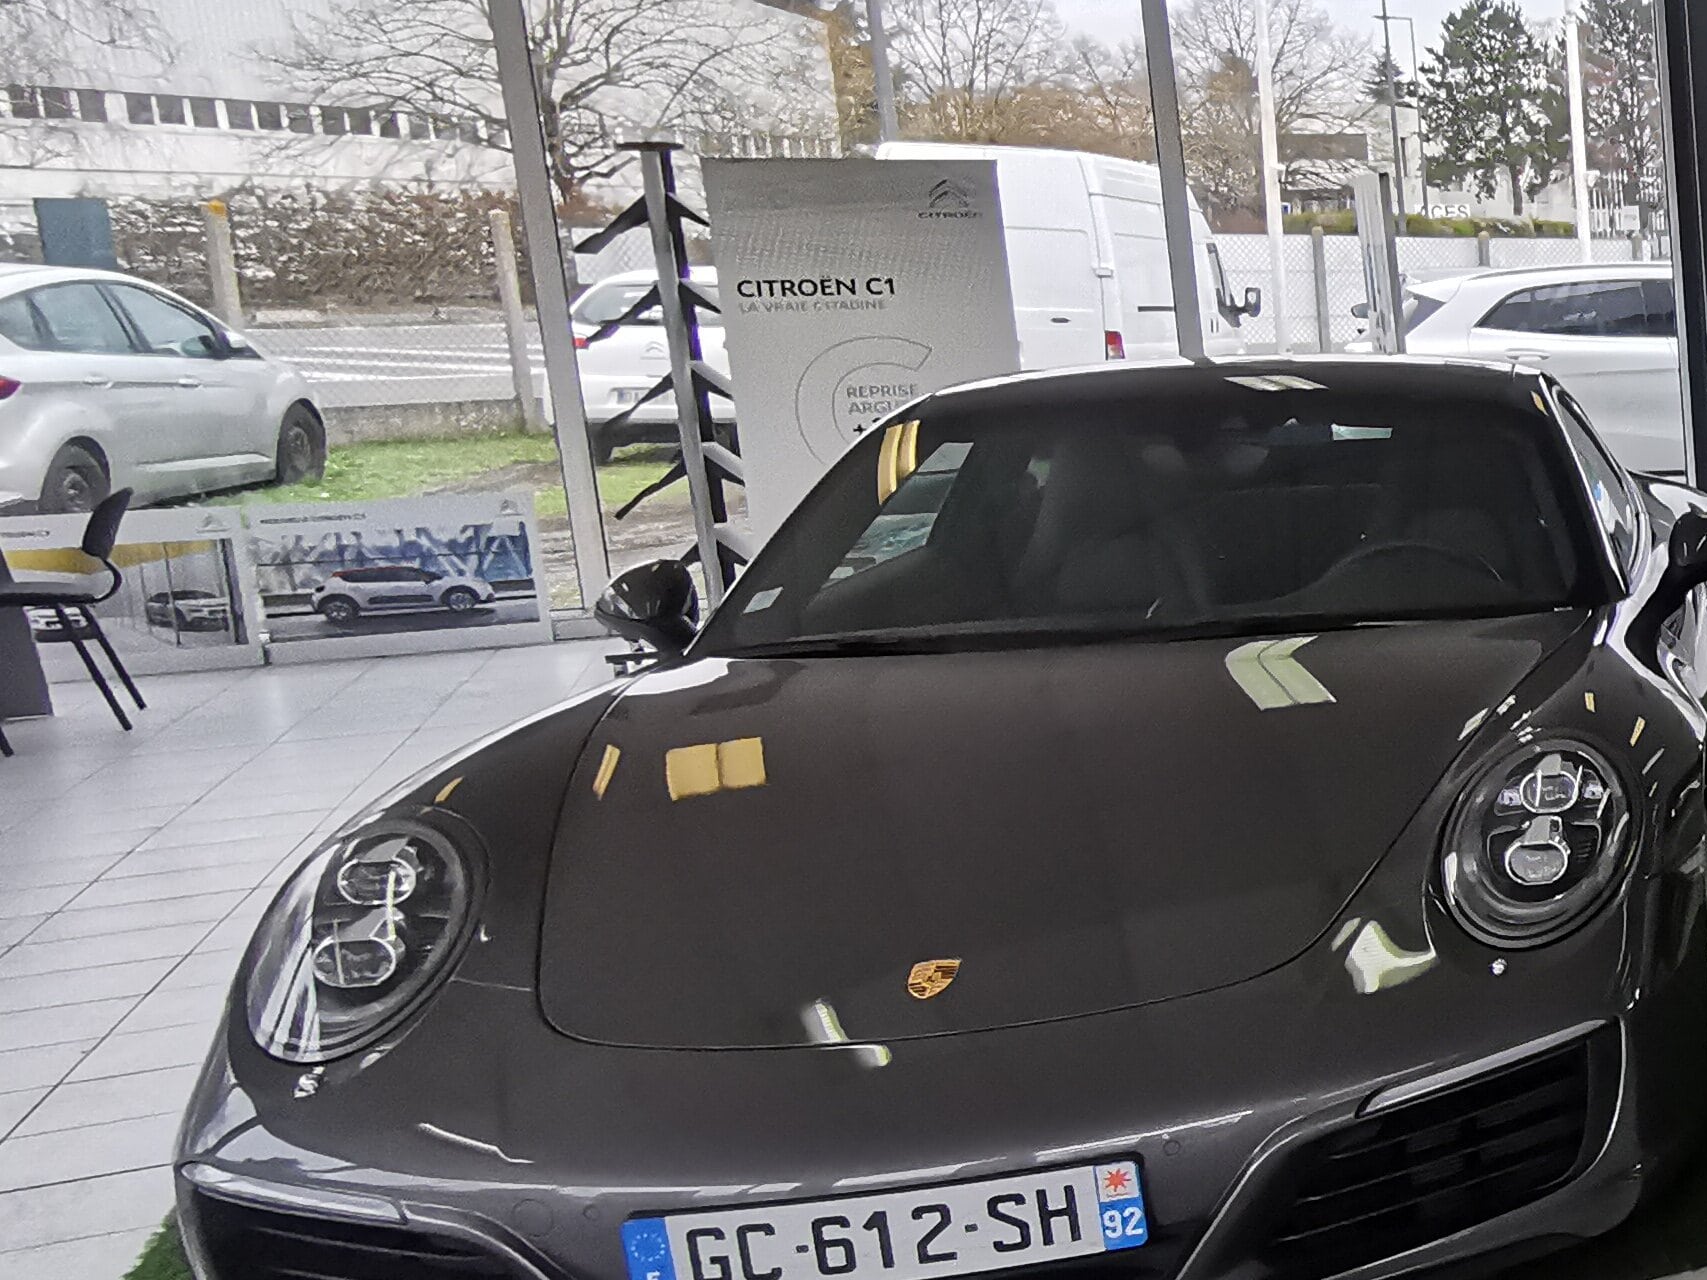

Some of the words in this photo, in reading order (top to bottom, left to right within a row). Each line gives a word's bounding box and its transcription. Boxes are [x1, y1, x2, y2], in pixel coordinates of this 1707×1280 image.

[736, 275, 857, 298] CITROËN
[865, 277, 896, 296] C1
[846, 383, 919, 399] REPRISE
[1102, 1206, 1145, 1239] 92
